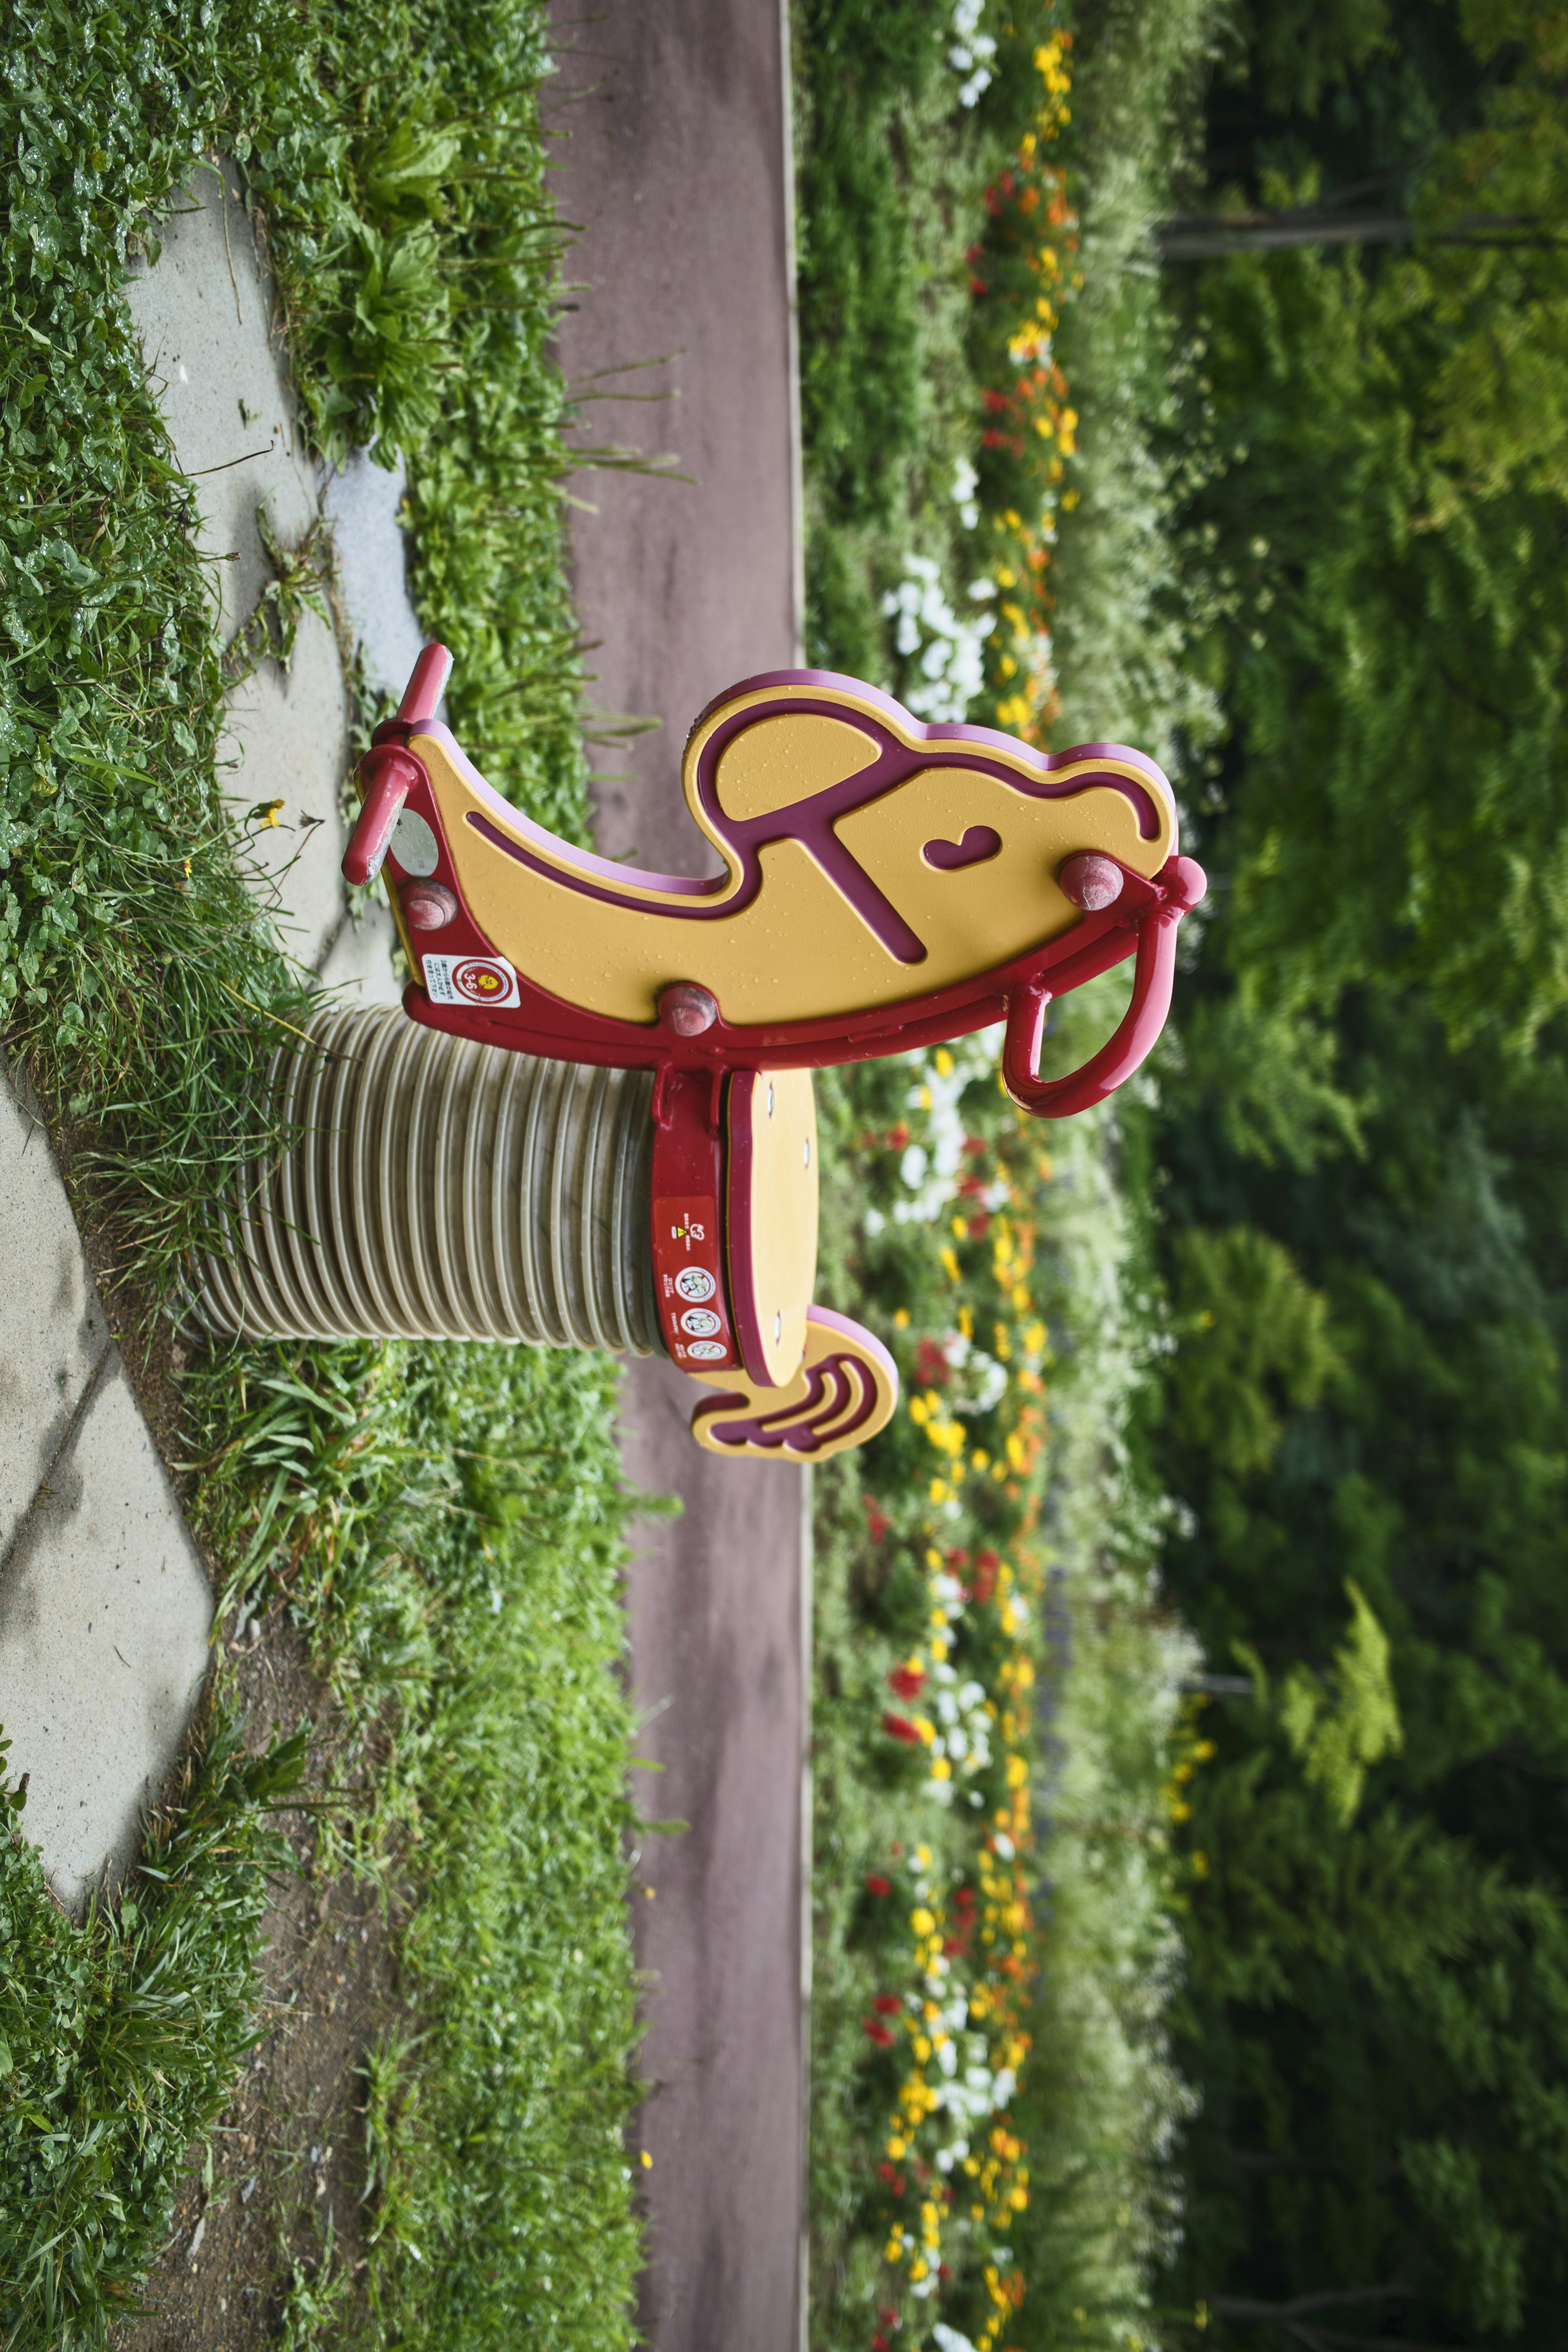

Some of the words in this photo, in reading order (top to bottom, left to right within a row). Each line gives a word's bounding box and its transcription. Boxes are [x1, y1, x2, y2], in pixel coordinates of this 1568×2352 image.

[426, 960, 438, 998] 付き添って下さい
[434, 963, 445, 996] には大人が必ず
[464, 973, 478, 990] 3-6
